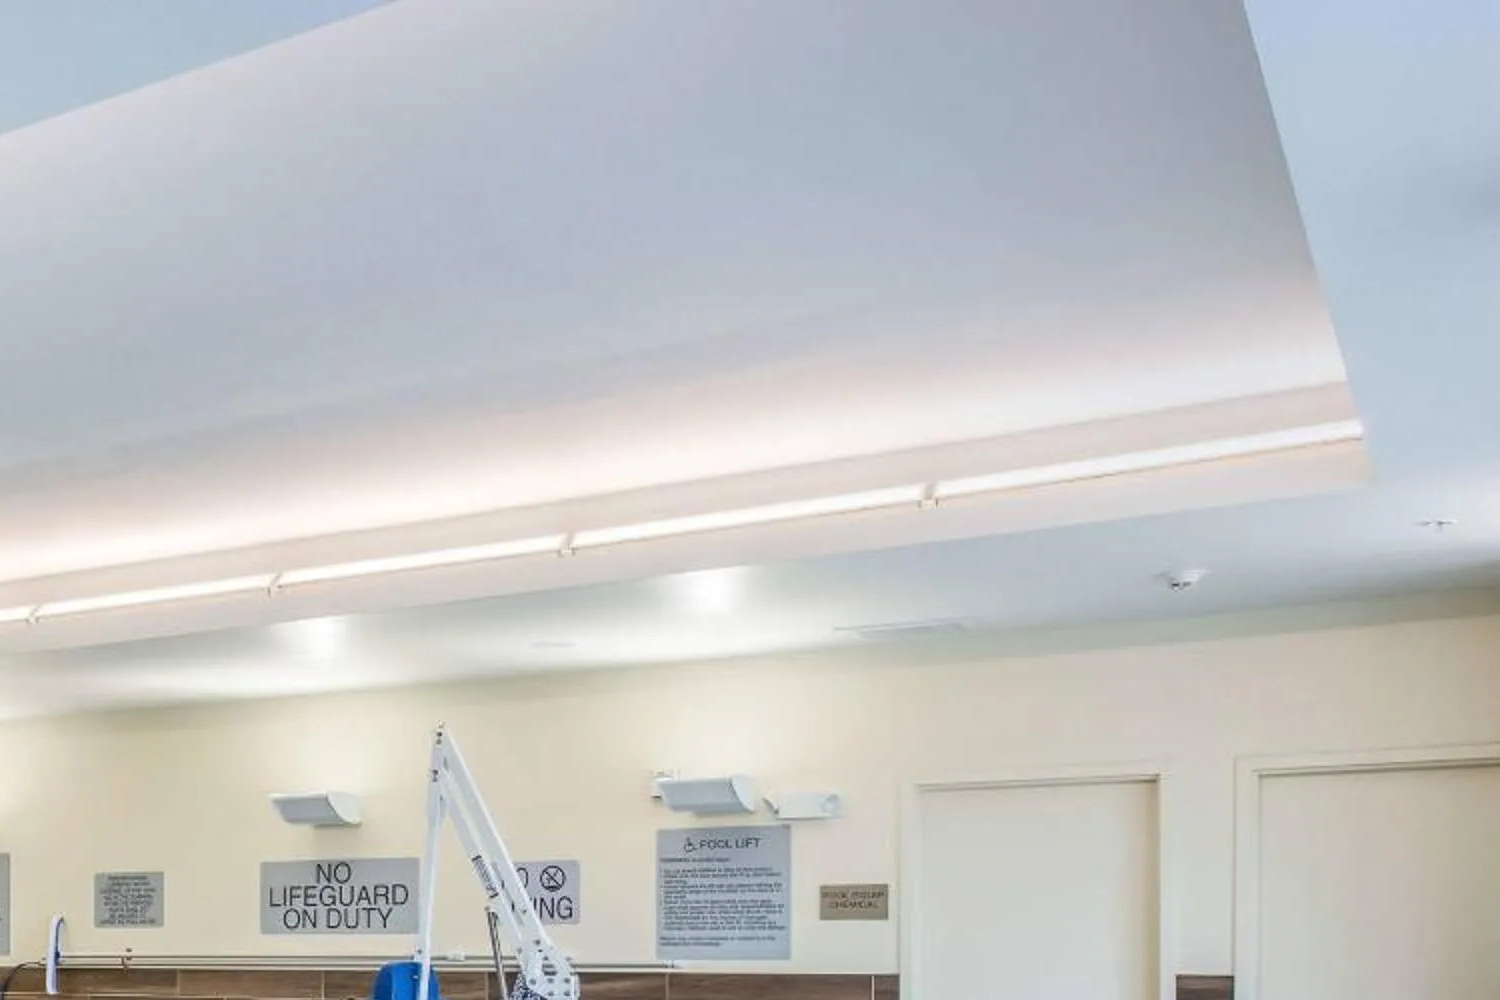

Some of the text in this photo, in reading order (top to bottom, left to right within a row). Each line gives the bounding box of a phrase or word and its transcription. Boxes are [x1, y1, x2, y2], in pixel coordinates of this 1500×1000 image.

[735, 837, 762, 849] LIFT
[316, 862, 351, 884] NO
[269, 884, 409, 907] LIFEGUARD
[283, 907, 393, 929] ON DUTY
